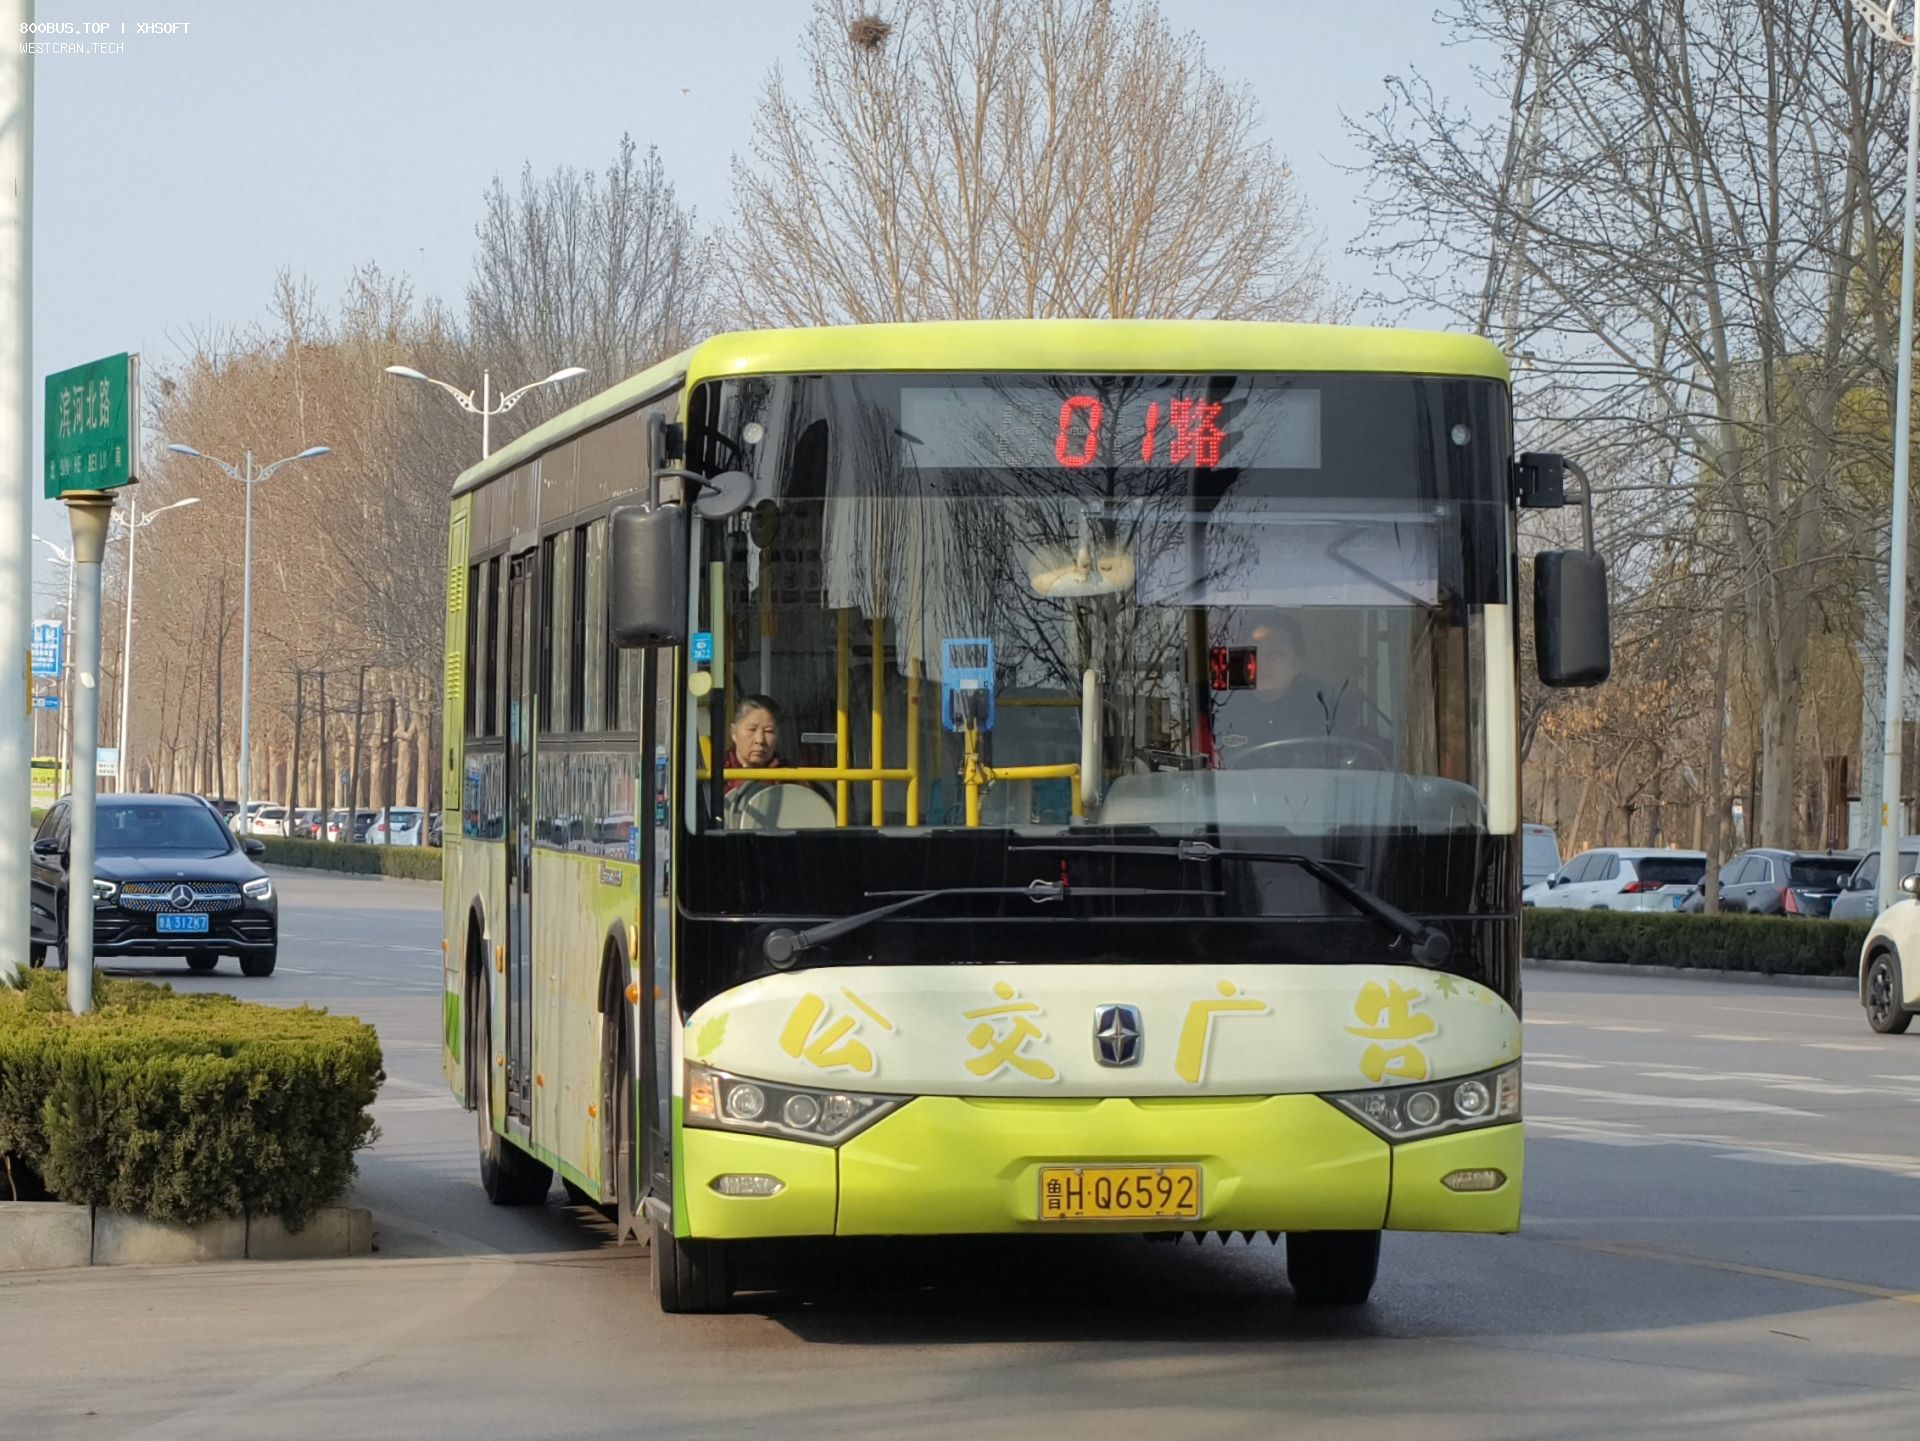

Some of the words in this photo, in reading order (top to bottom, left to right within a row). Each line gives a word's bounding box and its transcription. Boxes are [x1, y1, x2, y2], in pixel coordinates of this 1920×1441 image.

[58, 376, 110, 439] 滨河北路
[778, 978, 1438, 1086] 公交广告
